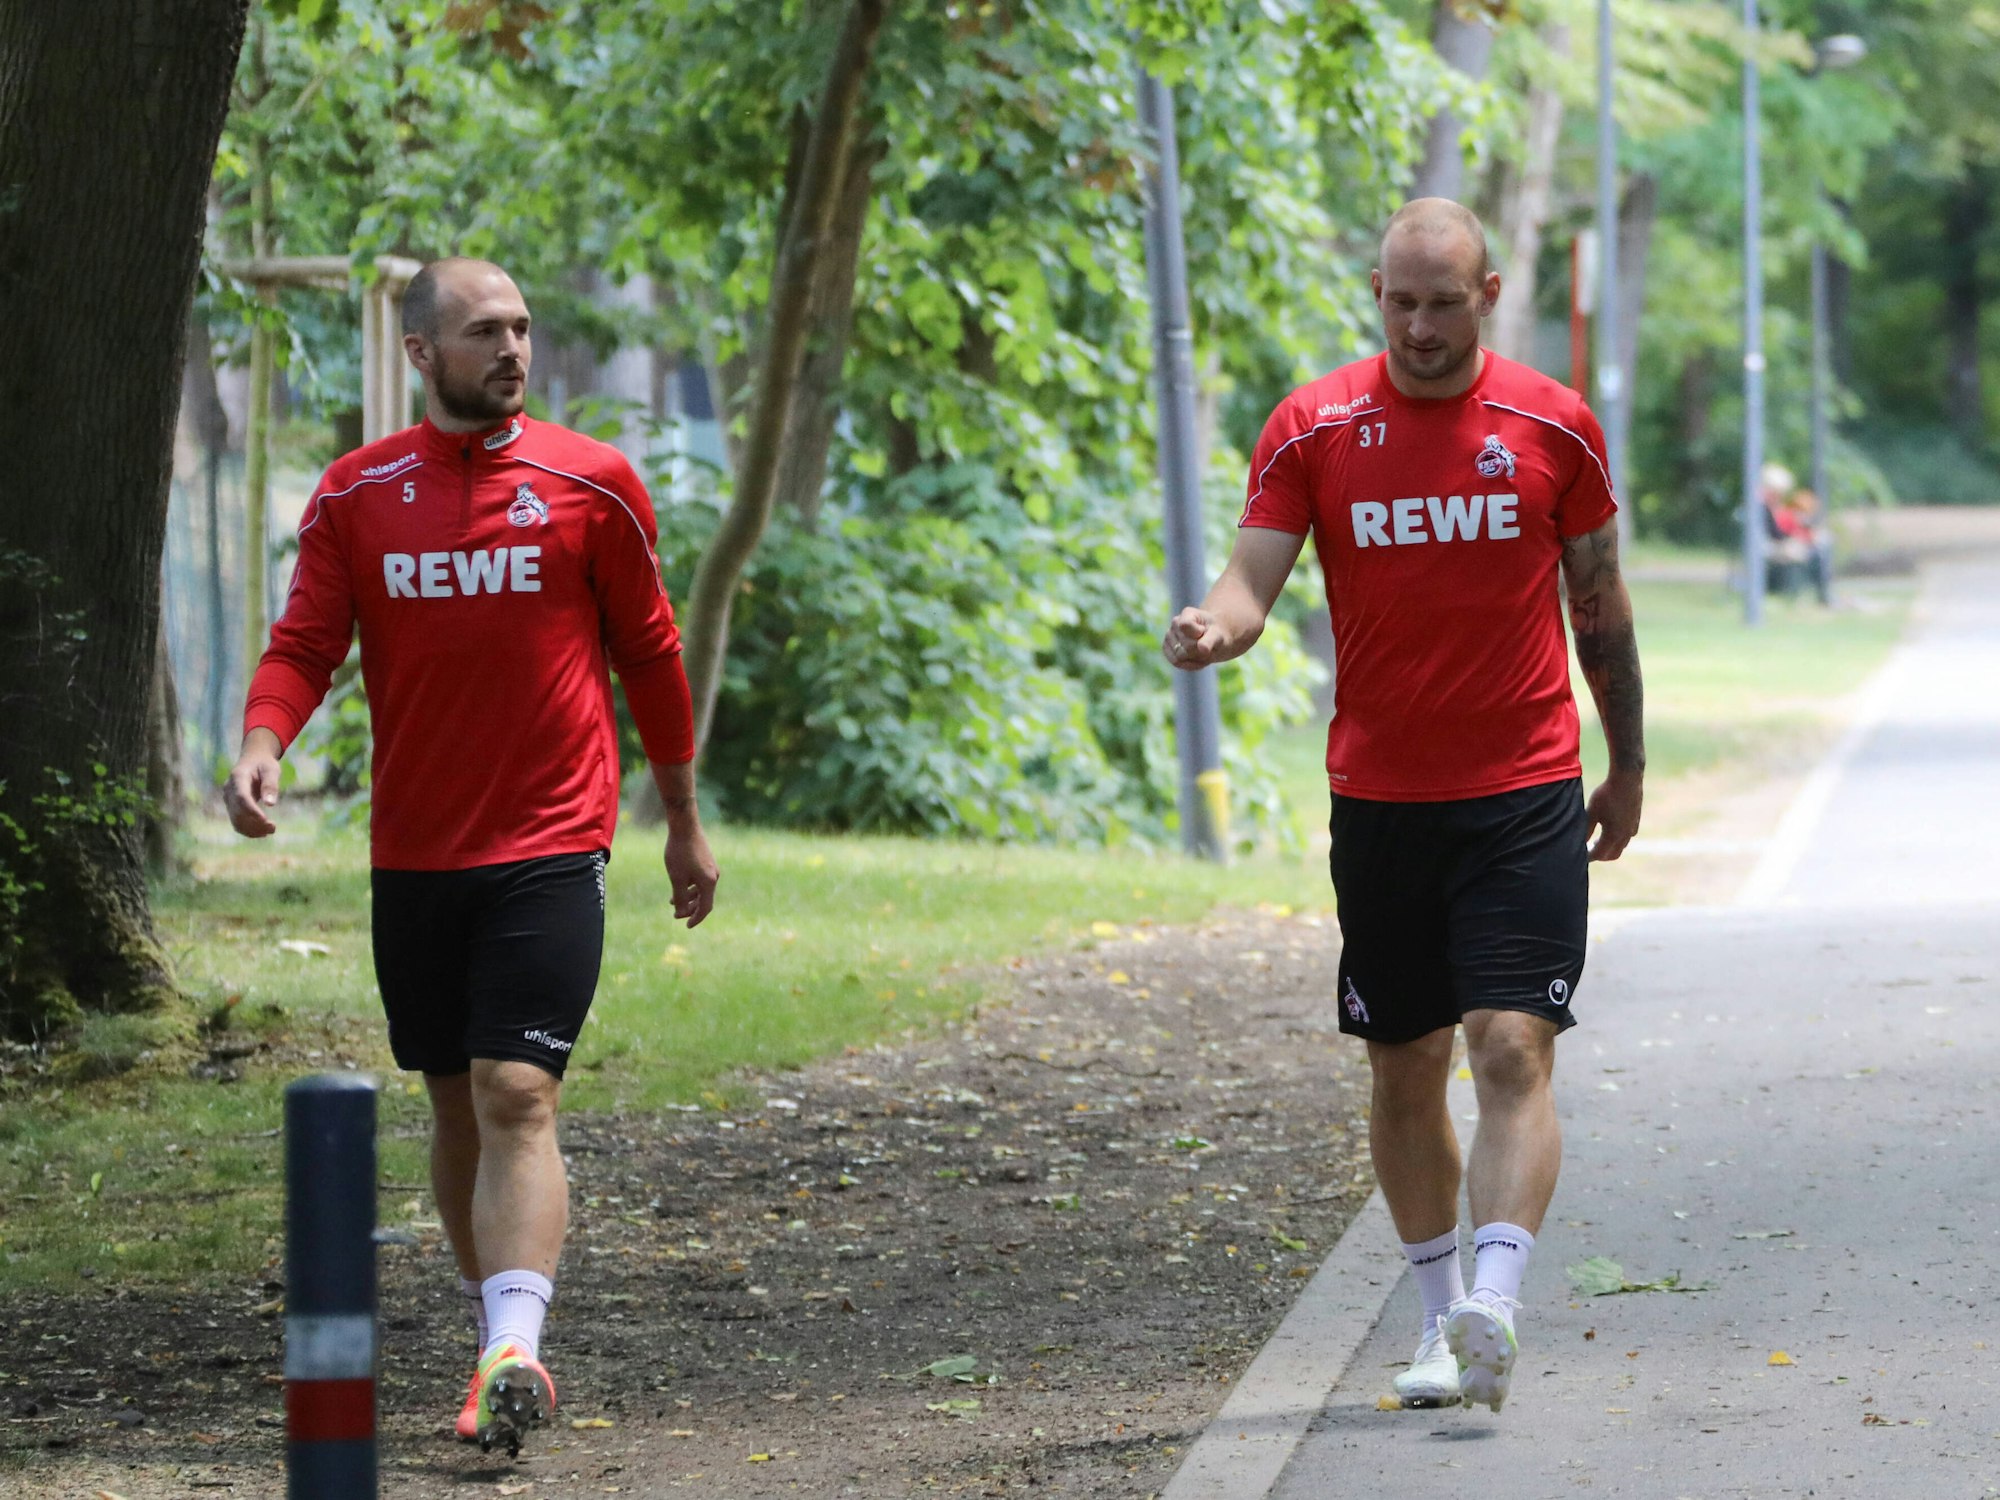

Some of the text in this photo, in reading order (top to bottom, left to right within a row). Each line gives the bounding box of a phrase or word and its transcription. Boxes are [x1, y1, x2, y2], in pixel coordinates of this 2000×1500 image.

[1318, 393, 1372, 416] uhlsport
[485, 430, 512, 447] uhlsp
[1359, 422, 1387, 448] 37
[360, 452, 417, 476] uhlsport
[402, 481, 415, 503] 5
[1350, 493, 1521, 548] REWE
[383, 545, 542, 599] REWE
